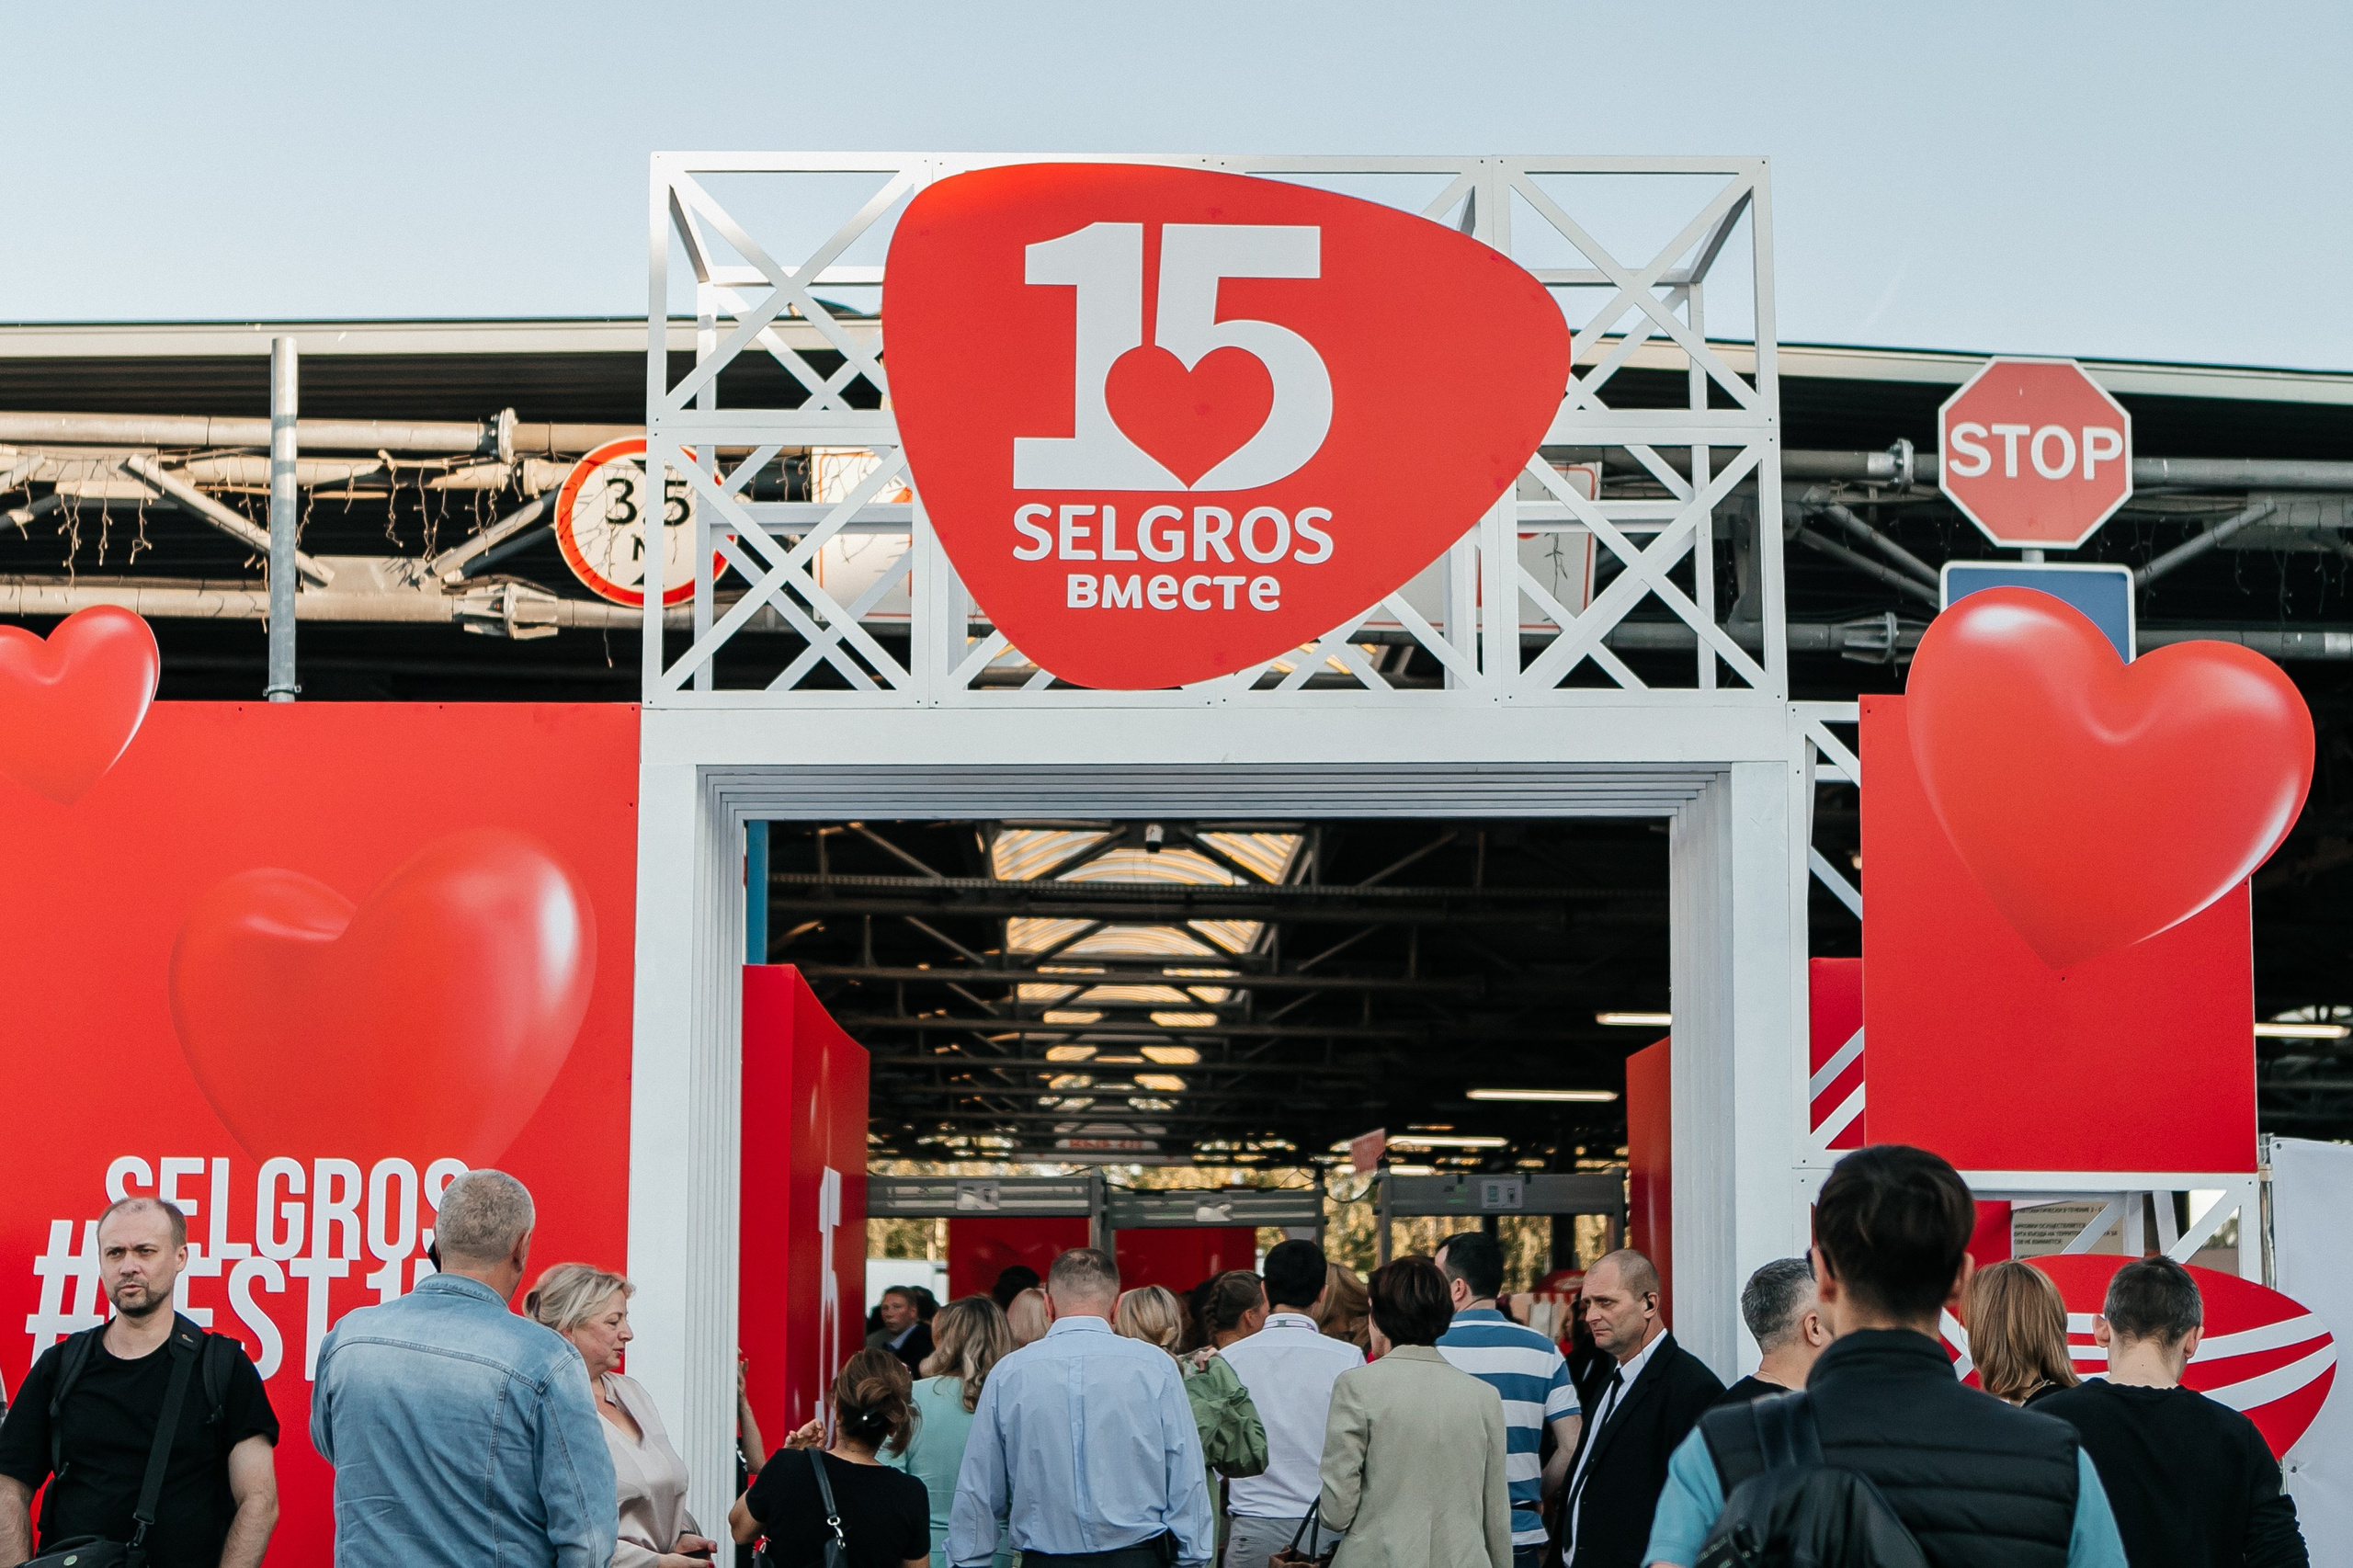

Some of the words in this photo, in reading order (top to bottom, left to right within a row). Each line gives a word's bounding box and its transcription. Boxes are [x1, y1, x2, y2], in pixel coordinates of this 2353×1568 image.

[1013, 222, 1334, 493] 15
[1949, 422, 2124, 481] STOP
[605, 477, 690, 527] 35
[1013, 503, 1335, 564] SELGROS
[25, 1220, 439, 1381] #EST
